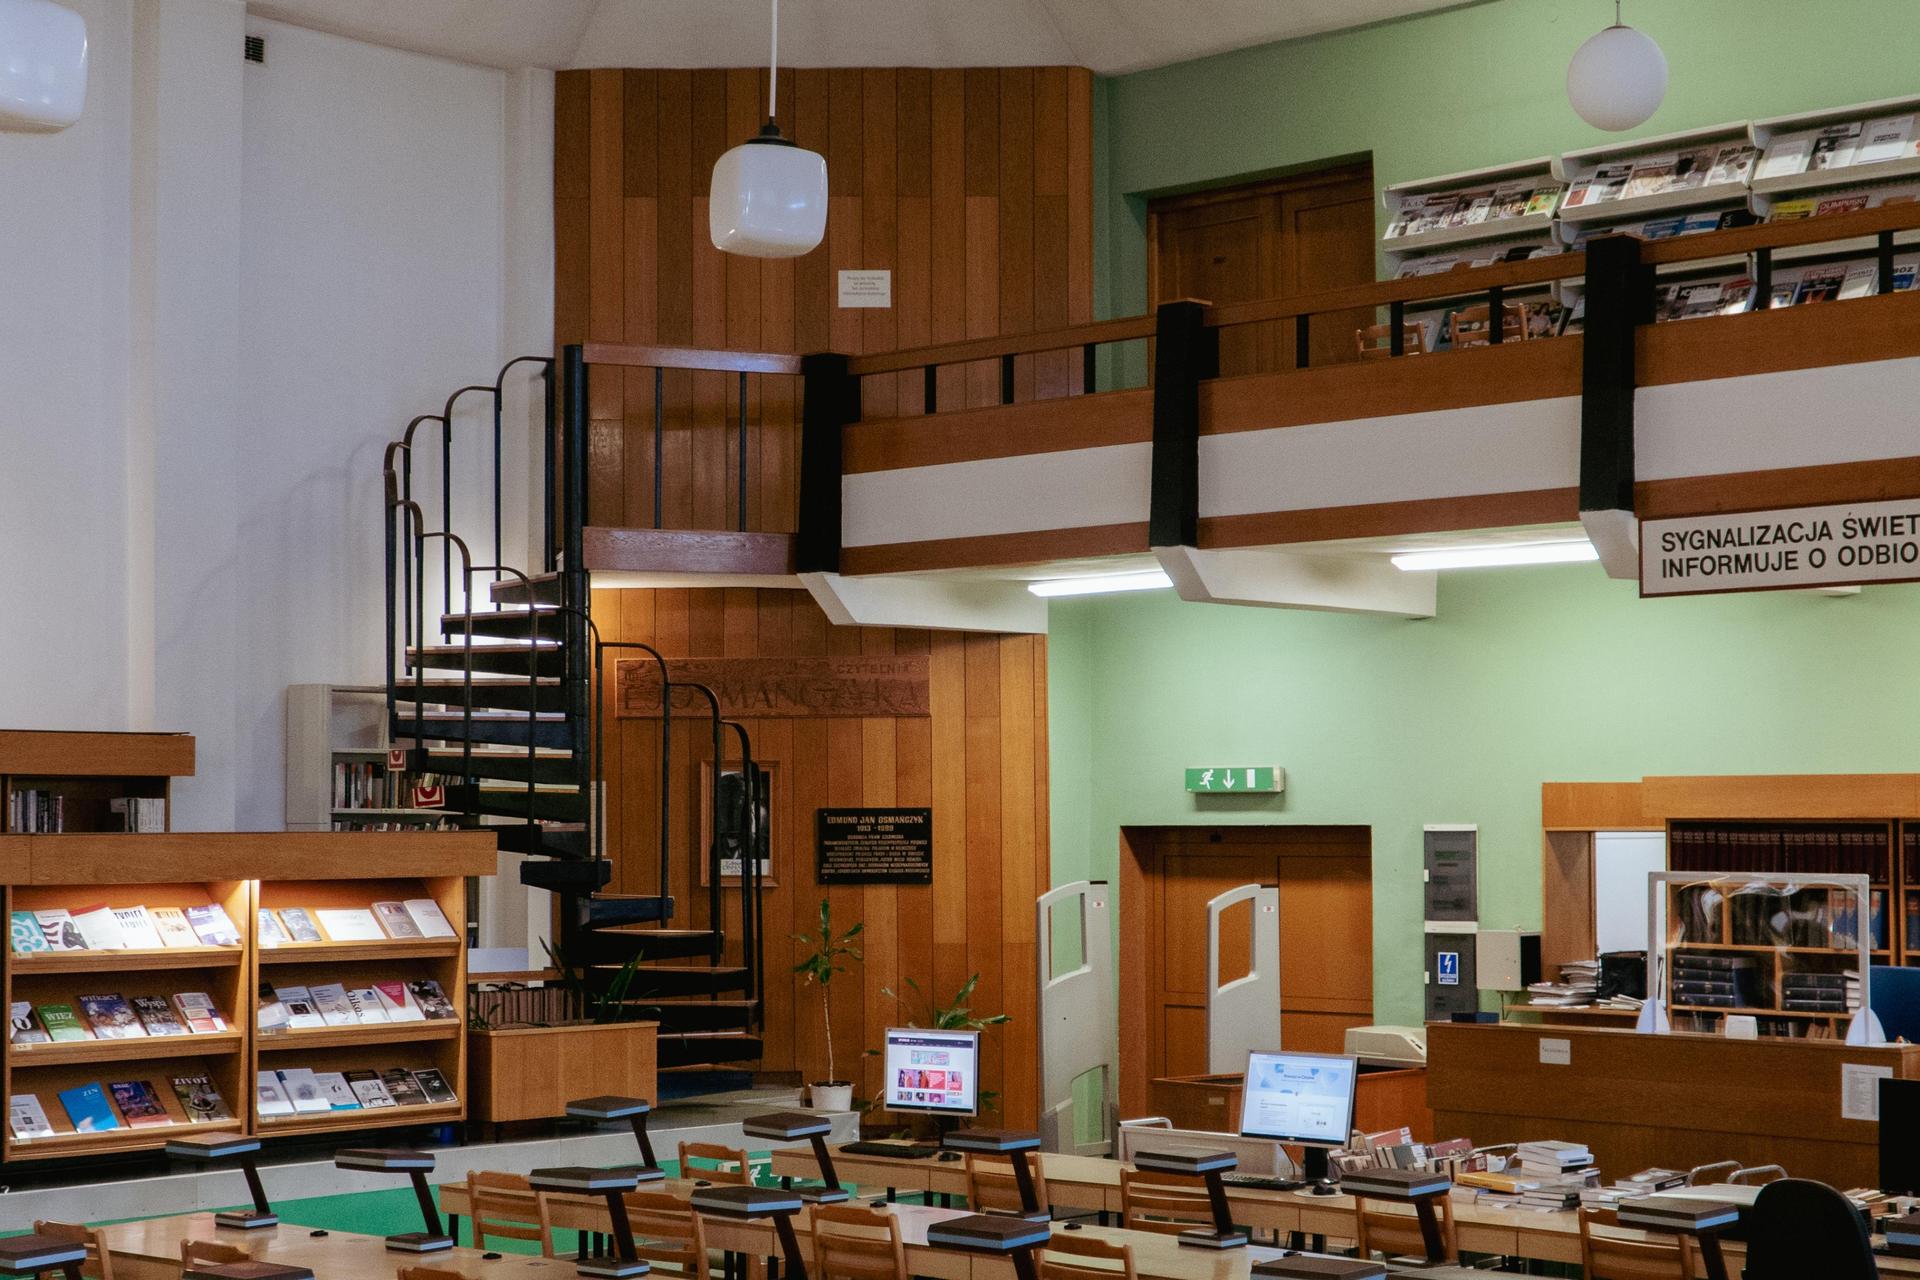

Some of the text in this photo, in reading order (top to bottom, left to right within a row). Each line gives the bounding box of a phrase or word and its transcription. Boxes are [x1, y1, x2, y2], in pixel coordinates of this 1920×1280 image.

[1661, 512, 1920, 552] SYGNALIZACJA ŚWIET
[1662, 541, 1919, 578] INFORMUJE O ODBIO
[827, 816, 858, 824] EDMUND
[860, 816, 875, 824] JAN
